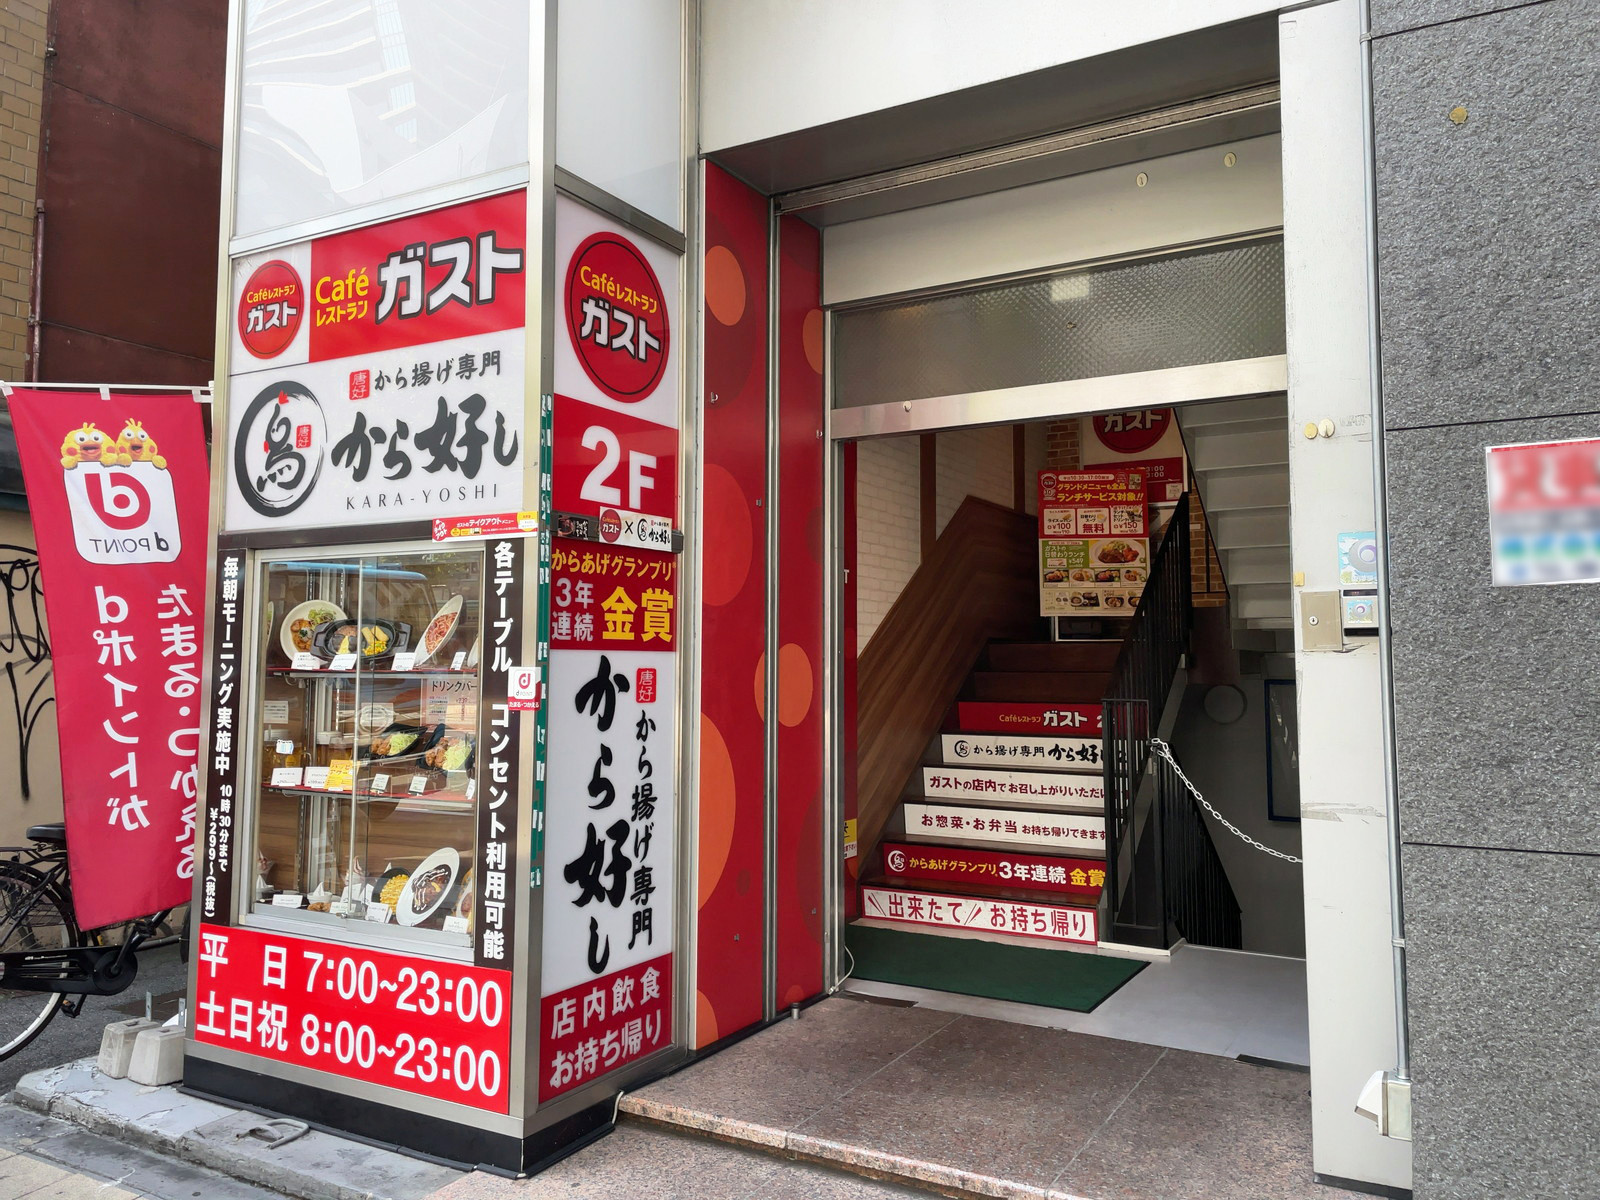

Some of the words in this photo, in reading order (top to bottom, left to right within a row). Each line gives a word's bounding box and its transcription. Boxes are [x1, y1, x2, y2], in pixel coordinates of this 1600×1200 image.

[315, 266, 369, 304] Café
[376, 231, 523, 323] ガスト
[246, 301, 297, 334] ガスト
[316, 300, 368, 327] レストラン
[581, 296, 660, 362] ガスト
[374, 350, 500, 391] から揚げ専門
[331, 393, 518, 482] から好し
[580, 425, 657, 510] 2F
[346, 484, 498, 510] KARA-YOSHI
[1083, 523, 1104, 533] 無料
[551, 548, 672, 581] からあげグランプリ
[491, 543, 516, 674] 各テーブル
[555, 577, 594, 609] 3年
[600, 586, 674, 642] 金賞
[551, 611, 594, 641] 連続
[214, 557, 239, 775] 毎朝モーニング実施中
[432, 680, 478, 692] ドリンクバー
[1043, 709, 1088, 728] ガスト
[974, 745, 1045, 758] から揚げ専門
[218, 784, 232, 872] 10時30分まで
[482, 703, 511, 960] コンセント利用可能
[563, 654, 632, 974] から好し
[628, 710, 658, 950] から揚げ専門
[998, 861, 1067, 885] 3年連続
[1069, 867, 1106, 887] 金賞
[888, 893, 963, 925] 出来たて
[990, 904, 1086, 937] お持ち帰り
[303, 951, 503, 1027] 7:00~23:00
[550, 966, 661, 1040] 店内飲食
[196, 991, 288, 1051] 土日祝
[300, 1014, 501, 1097] 8:00~23:00
[549, 1009, 661, 1089] お持ち帰り
